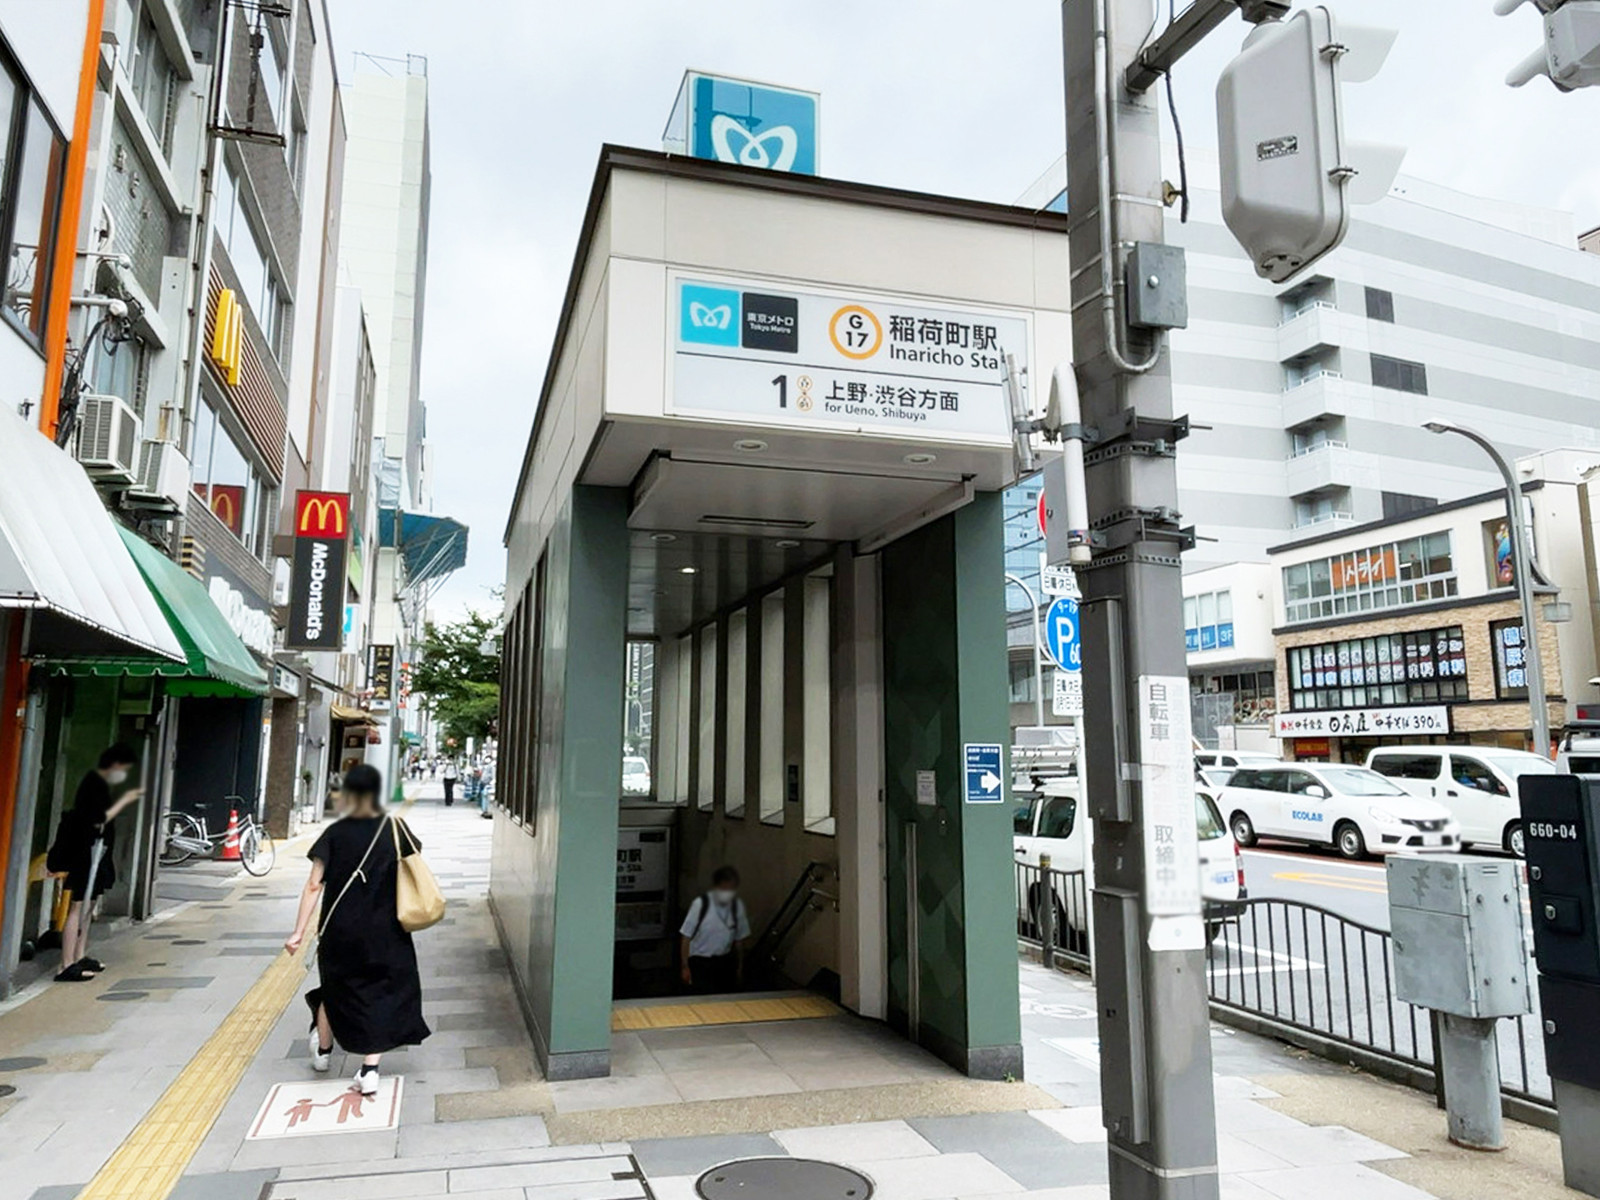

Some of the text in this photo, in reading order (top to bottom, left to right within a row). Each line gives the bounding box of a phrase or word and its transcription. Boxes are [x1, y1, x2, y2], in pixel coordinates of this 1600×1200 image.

[747, 312, 794, 327] 東京メトロ
[750, 322, 791, 334] Tokyo Metro
[849, 314, 863, 329] G
[845, 331, 869, 347] 17
[889, 315, 997, 351] 稲荷町駅
[890, 344, 964, 366] Inaricho
[771, 375, 787, 408] 1
[825, 402, 927, 422] for Ueno, Shibuya
[305, 541, 329, 641] McDonald's
[1055, 616, 1075, 664] P
[1149, 683, 1170, 741] 自転車
[1292, 810, 1323, 822] ECOLAB
[1529, 822, 1577, 839] 660-04
[1154, 824, 1176, 886] 取締中
